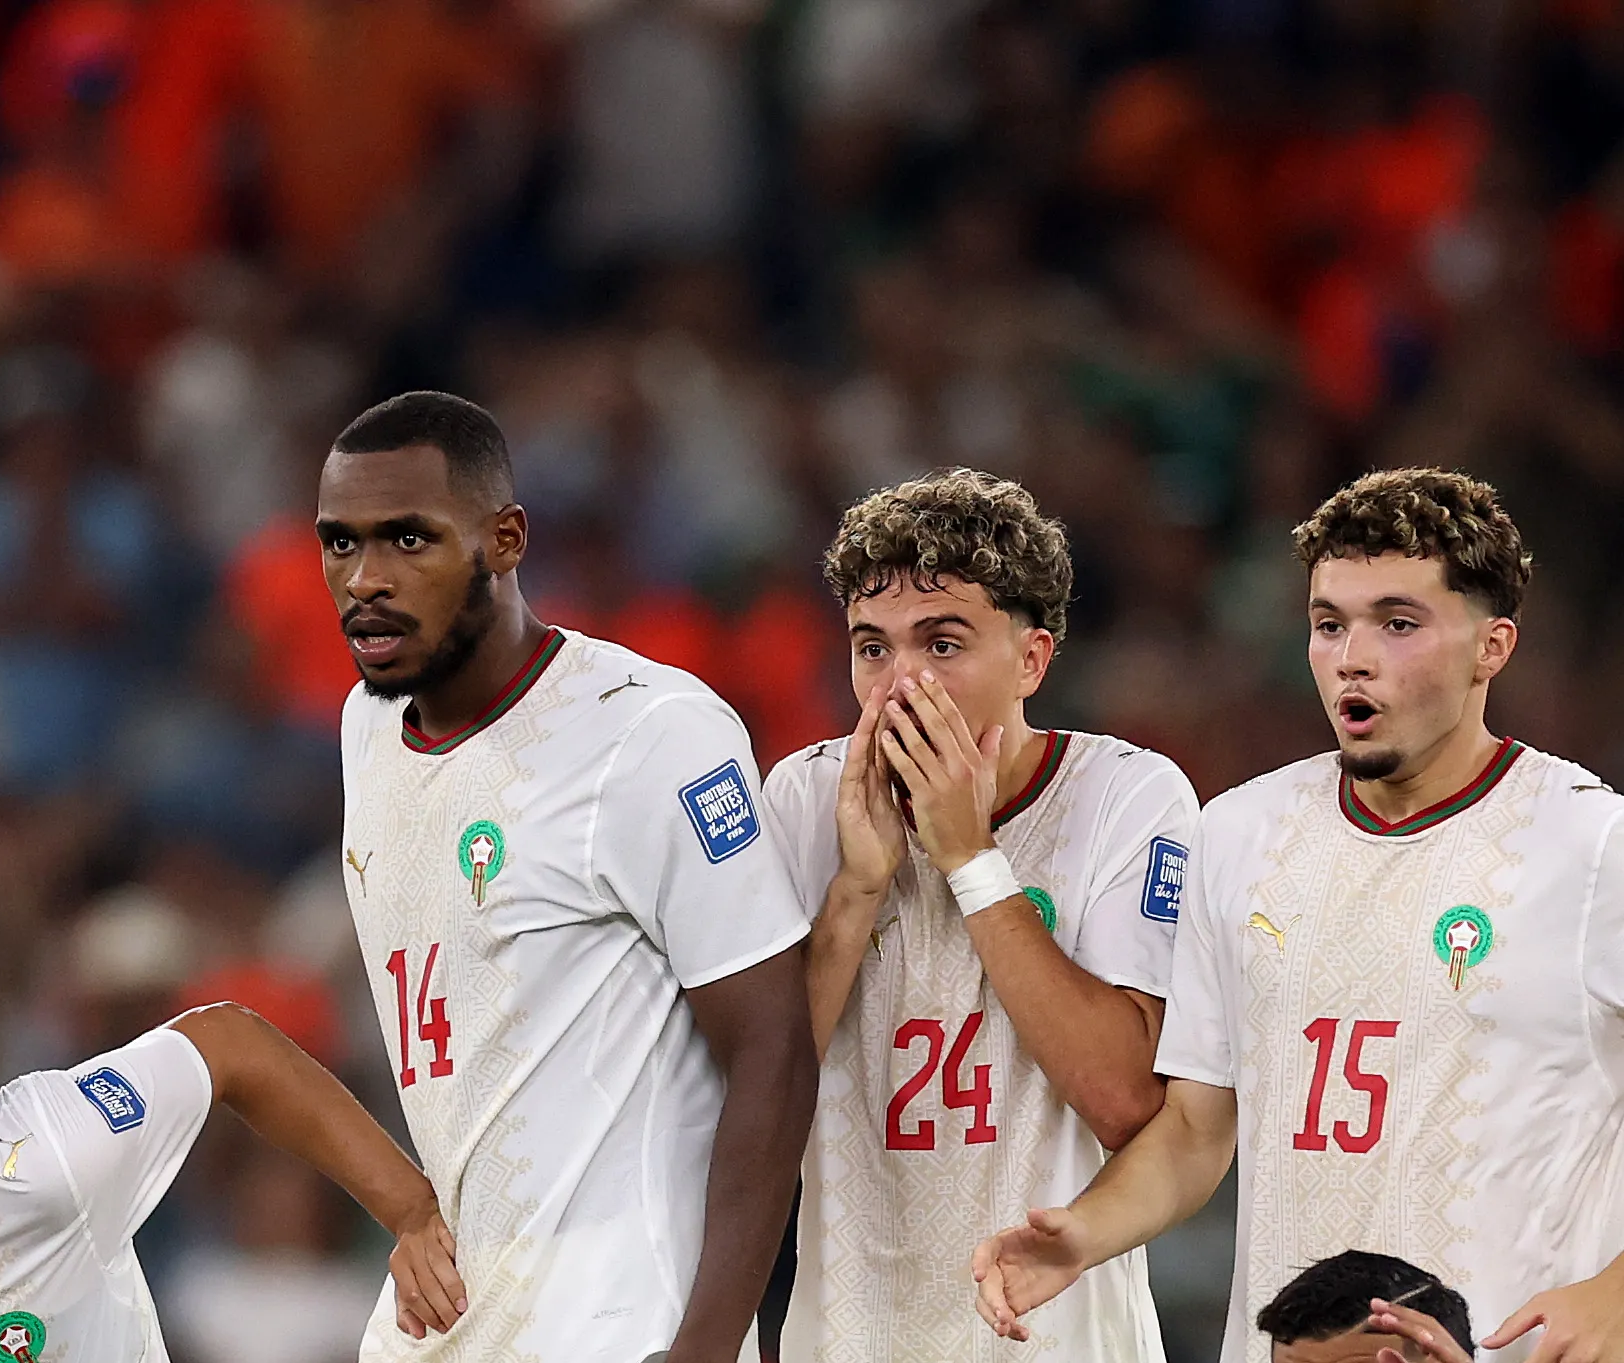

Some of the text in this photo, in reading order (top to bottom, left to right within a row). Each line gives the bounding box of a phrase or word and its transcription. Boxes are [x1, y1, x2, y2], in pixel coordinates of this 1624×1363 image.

[695, 776, 737, 807] FOOTBALL
[701, 788, 743, 823] UNITES
[707, 802, 751, 839] the World
[726, 826, 745, 841] FIFA
[1154, 884, 1173, 899] the
[387, 944, 454, 1088] 14
[886, 1012, 997, 1150] 24
[1293, 1018, 1401, 1155] 15
